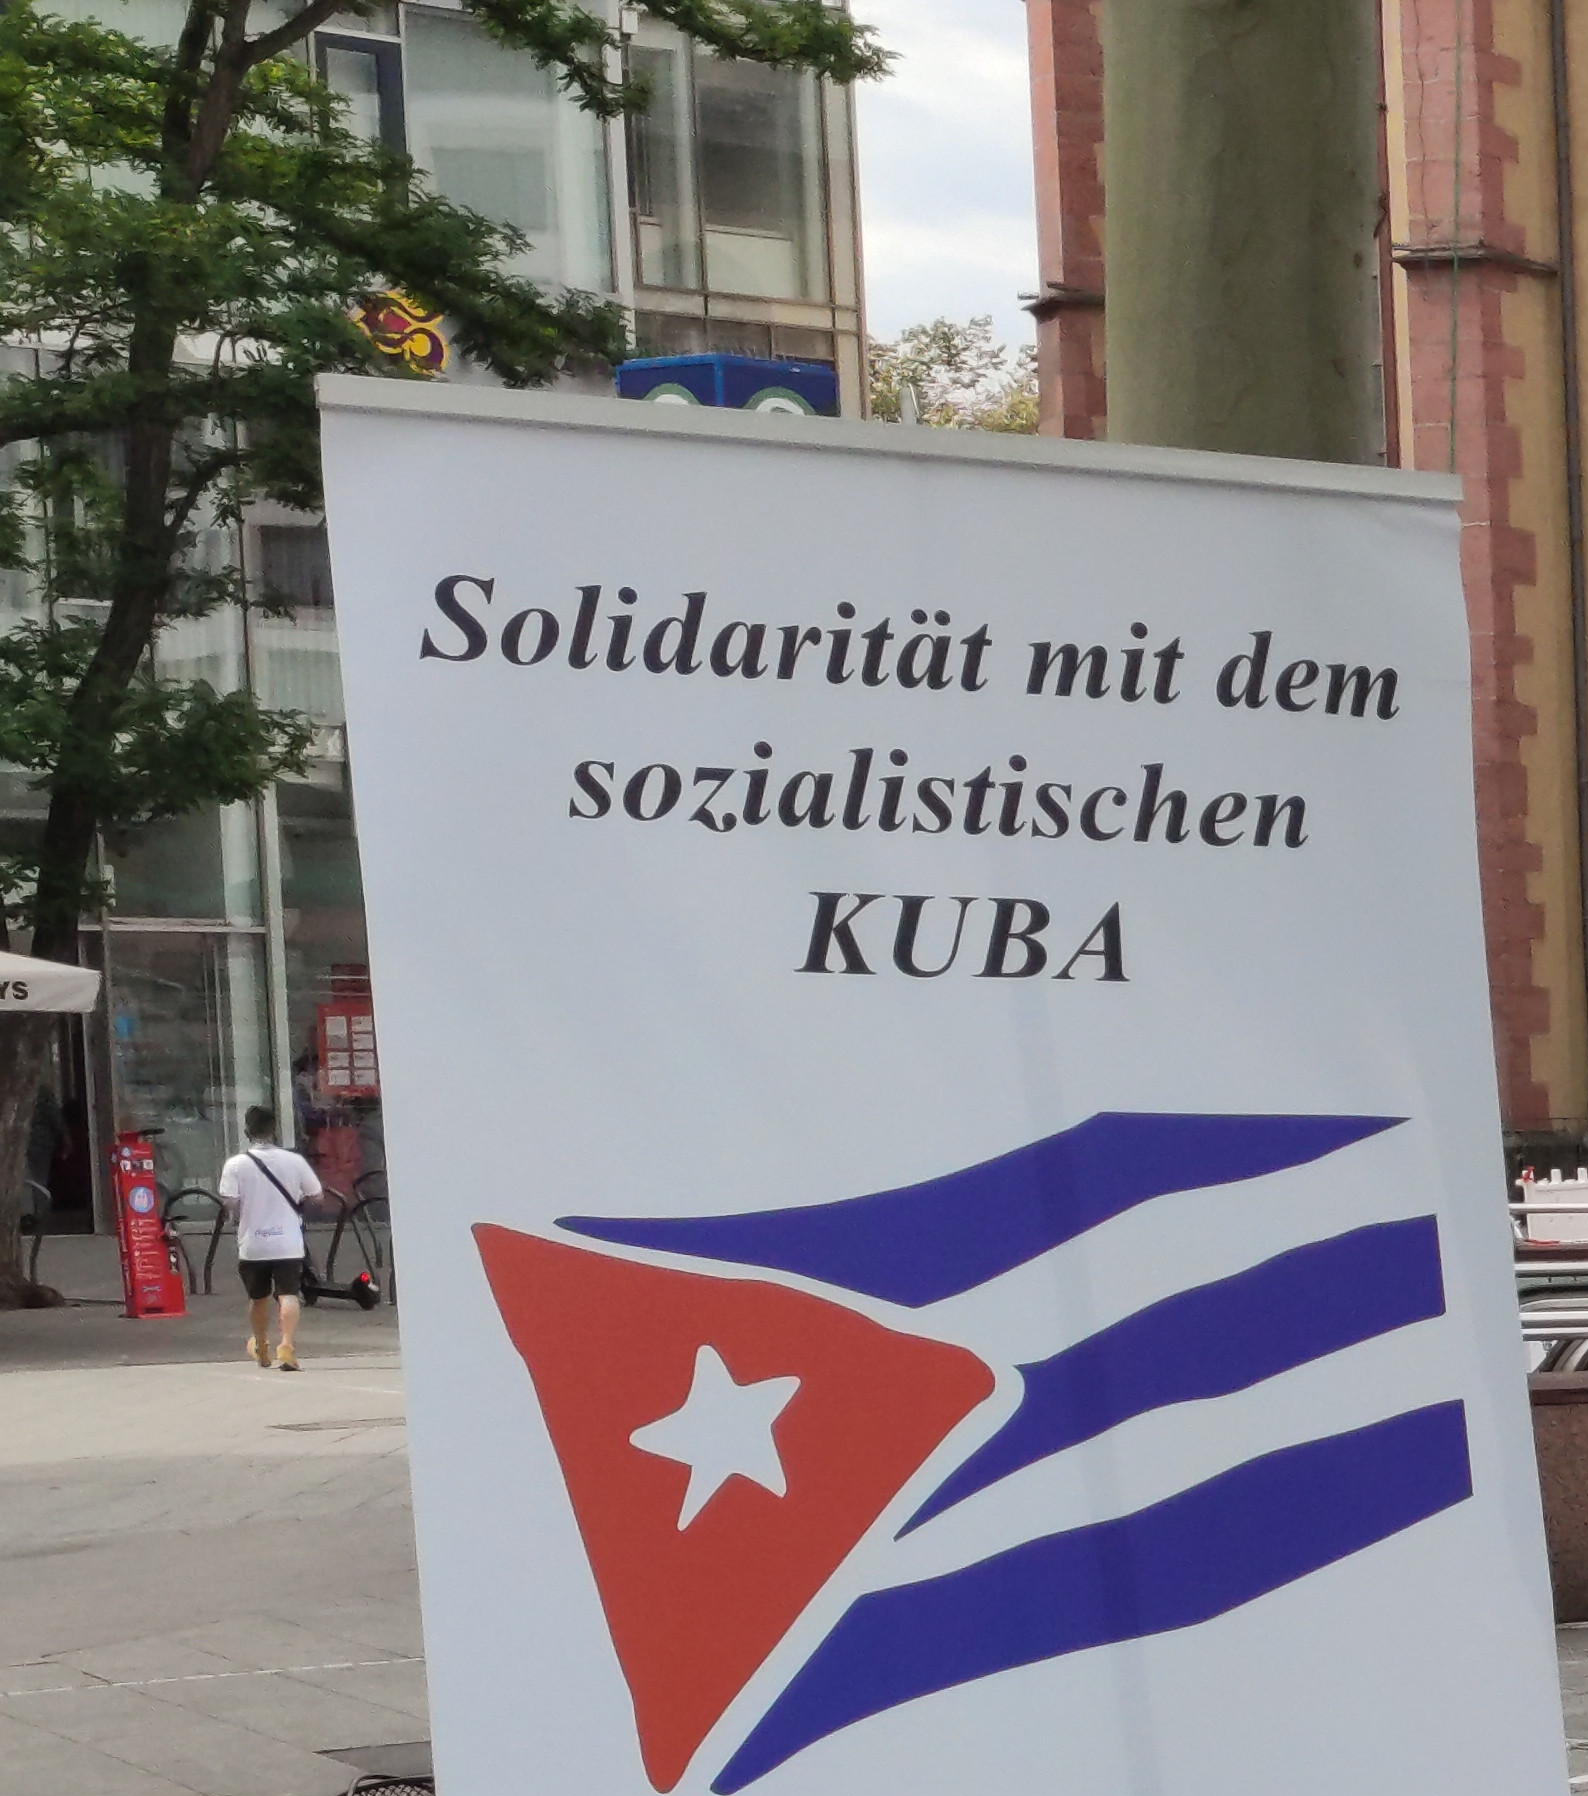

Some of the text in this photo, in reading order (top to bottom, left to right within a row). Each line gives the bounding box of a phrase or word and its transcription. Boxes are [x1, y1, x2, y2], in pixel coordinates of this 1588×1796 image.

[419, 574, 1401, 720] Solidarität mit dem
[567, 740, 1309, 849] sozialistischen
[793, 890, 1131, 982] KUBA
